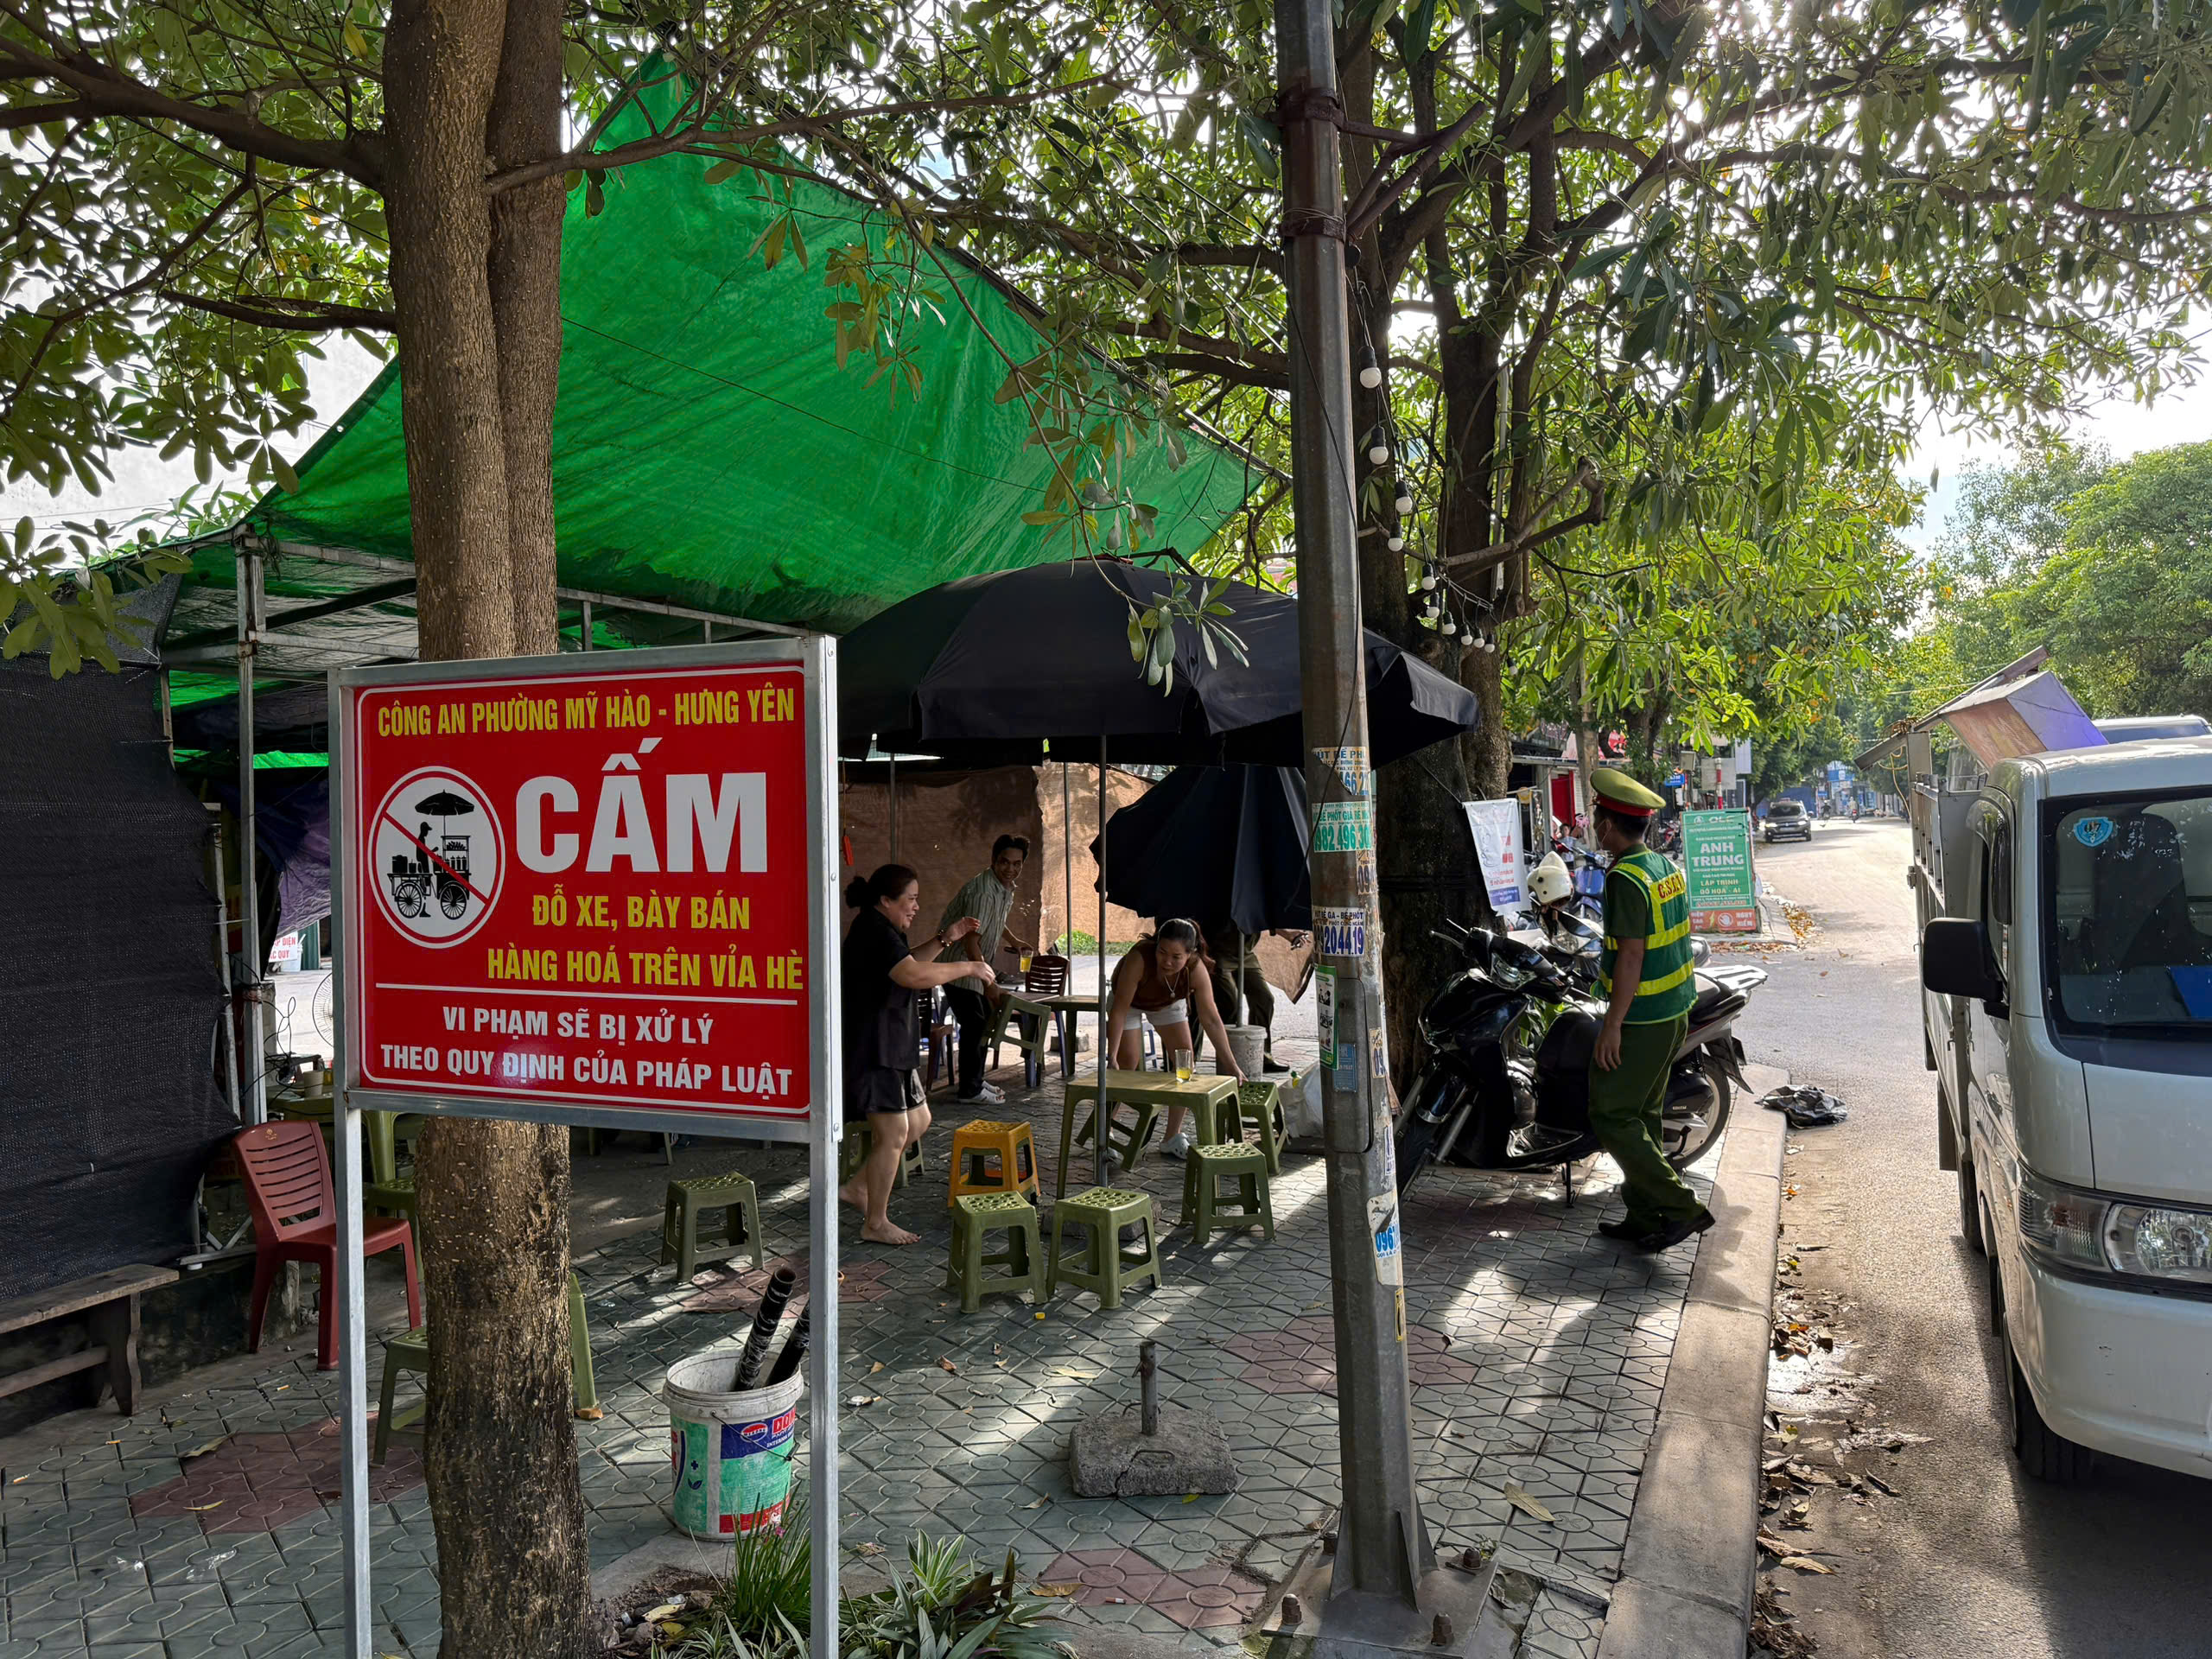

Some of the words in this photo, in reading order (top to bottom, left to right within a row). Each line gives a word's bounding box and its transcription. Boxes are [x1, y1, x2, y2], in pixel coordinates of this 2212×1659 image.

[378, 699, 431, 737] CÔNG
[437, 703, 466, 734] AN
[473, 692, 558, 733] PHƯỜNG
[565, 690, 599, 729] MỸ
[607, 689, 651, 728] HÀO
[675, 689, 739, 725] HƯNG
[747, 682, 794, 722] YÊN
[515, 737, 767, 874] CẤM
[1691, 854, 1745, 867] TRUNG
[1700, 842, 1734, 854] ANH
[532, 883, 567, 926] ĐỖ
[576, 896, 618, 931] XE,
[627, 889, 681, 929] BÀY
[690, 889, 750, 930] BÁN
[487, 942, 557, 982] HÀNG
[567, 945, 620, 983] HOÁ
[629, 947, 700, 986] TRÊN
[709, 944, 757, 988] VỈA
[766, 950, 804, 989] HÈ
[442, 1007, 465, 1031] VI
[474, 1008, 548, 1040] PHẠM
[557, 1008, 588, 1039] SẼ
[600, 1014, 626, 1046] BỊ
[635, 1008, 675, 1042] XỬ
[682, 1014, 713, 1045] LÝ
[380, 1045, 439, 1071] THEO
[447, 1051, 494, 1077] QUY
[502, 1052, 564, 1084] ĐỊNH
[574, 1050, 626, 1085] CỦA
[637, 1058, 711, 1090] PHÁP
[721, 1063, 792, 1100] LUẬT
